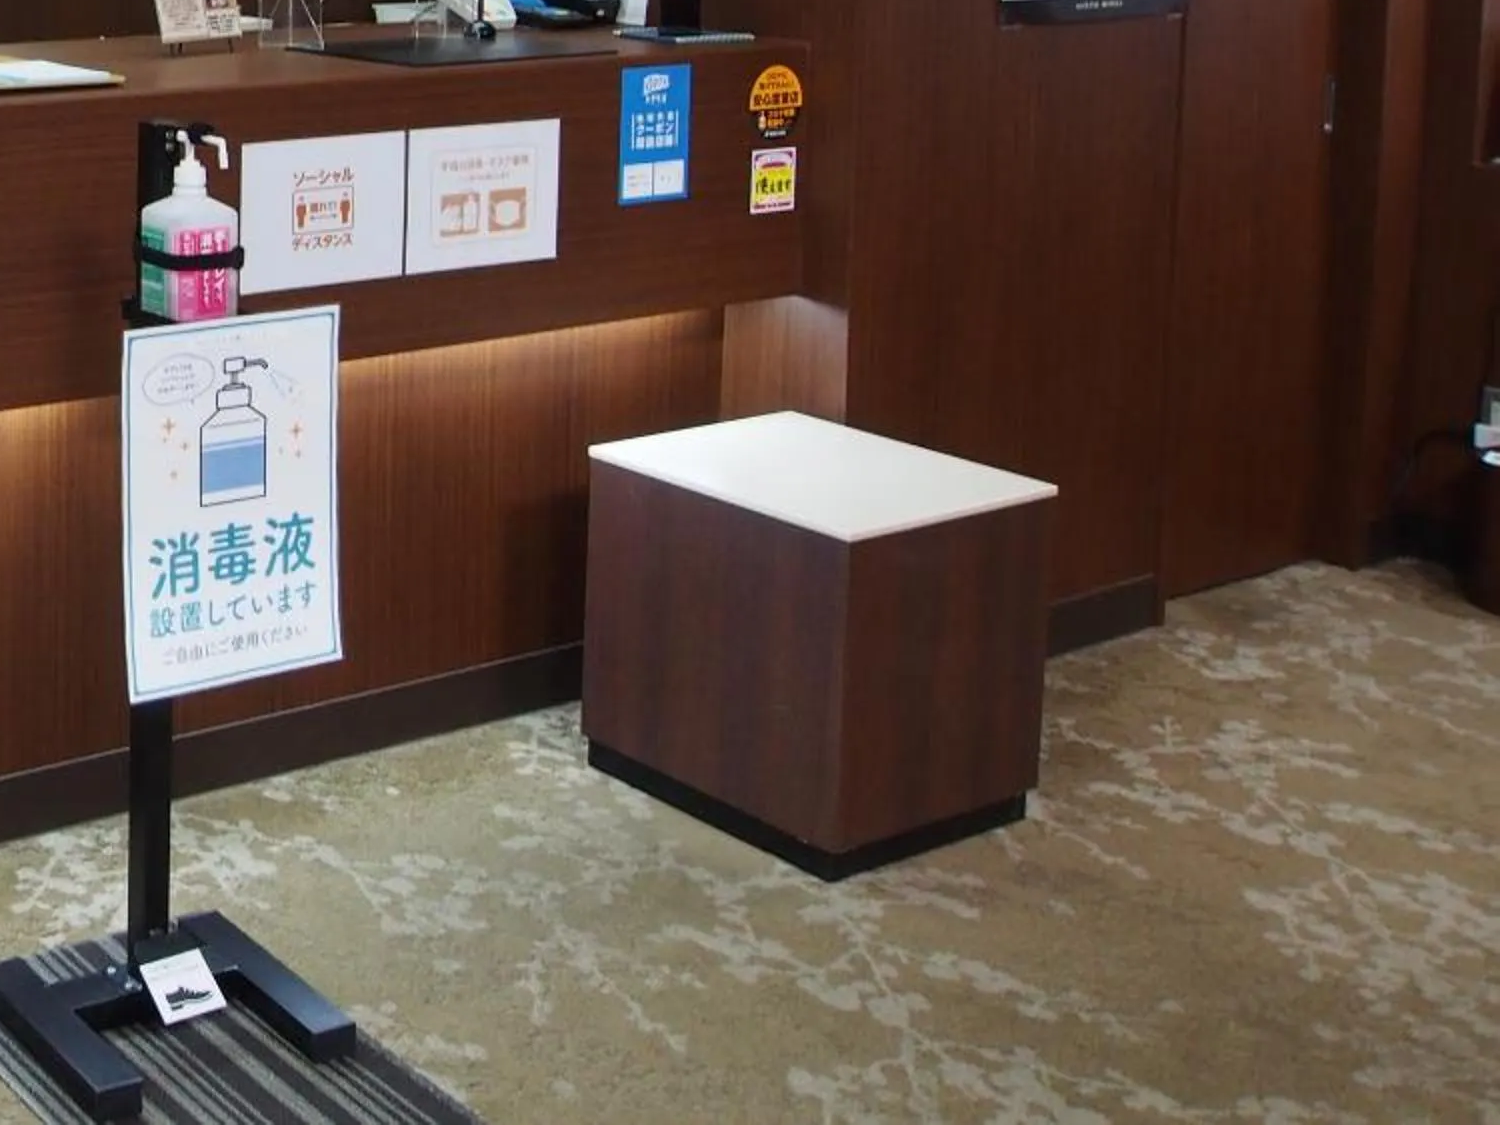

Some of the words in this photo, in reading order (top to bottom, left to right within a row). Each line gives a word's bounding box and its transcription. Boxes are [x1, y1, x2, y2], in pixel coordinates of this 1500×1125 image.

[293, 166, 355, 188] ソーシャル
[291, 233, 353, 252] ディスタンス
[148, 511, 315, 600] 消毒液
[149, 579, 318, 639] 設置しています
[161, 625, 309, 666] ご自由にご使用ください
